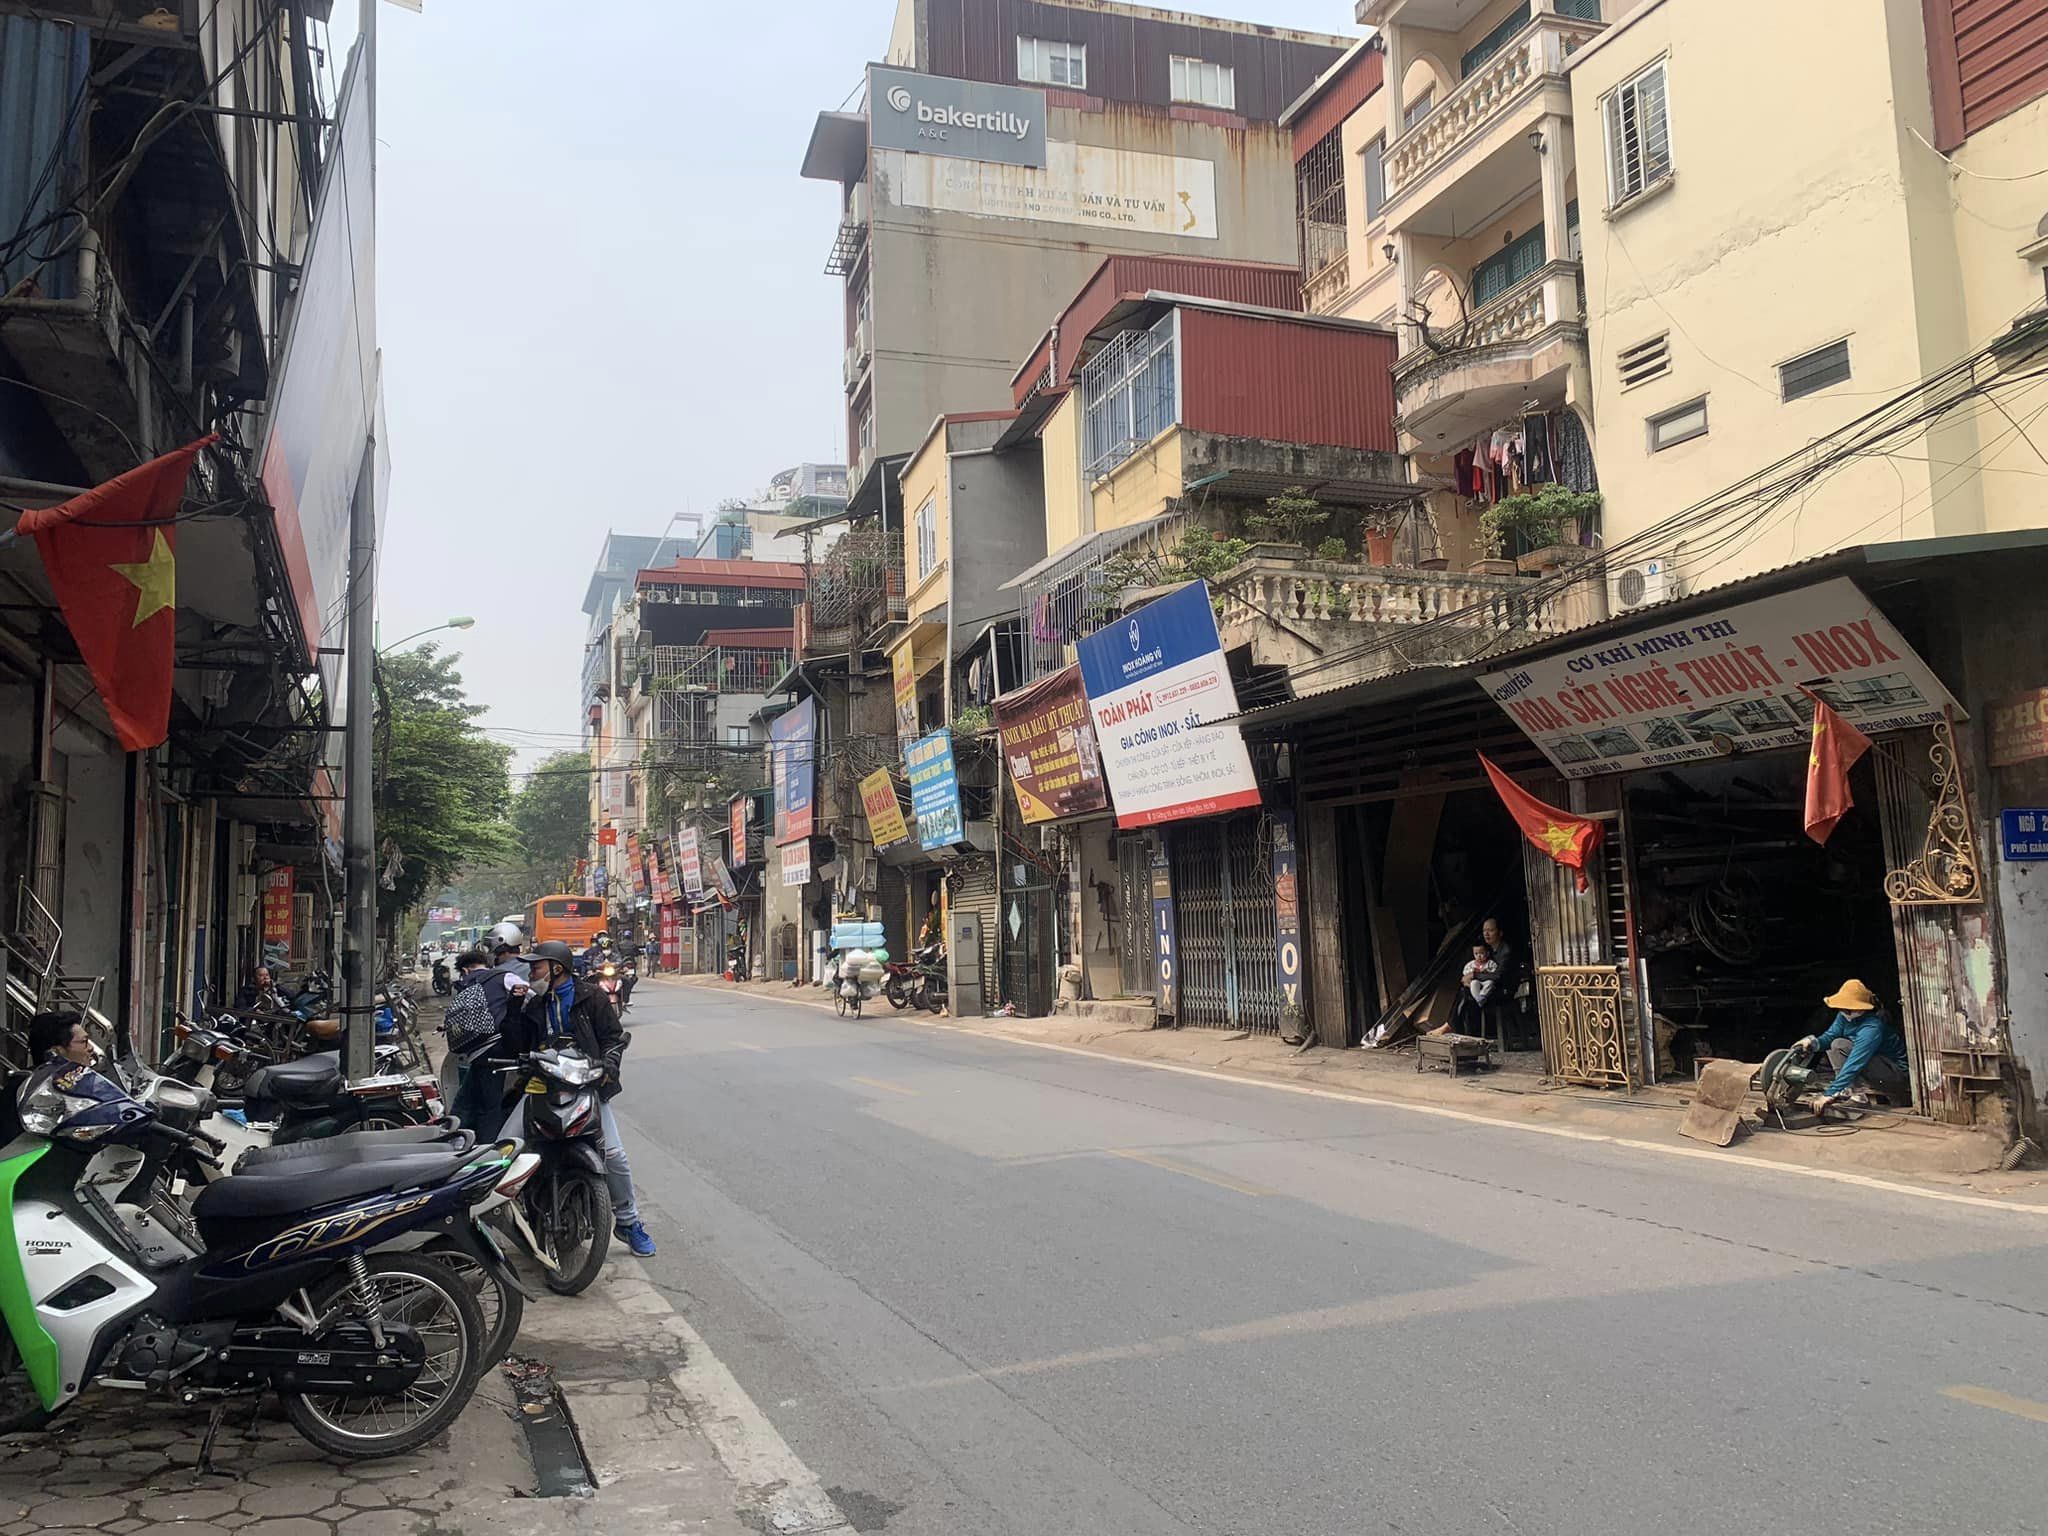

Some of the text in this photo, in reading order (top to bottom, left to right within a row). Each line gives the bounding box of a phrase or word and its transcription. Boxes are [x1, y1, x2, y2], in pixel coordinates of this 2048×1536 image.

[917, 100, 1030, 139] bakertilly
[1633, 631, 1693, 657] MINH
[1692, 619, 1737, 641] THI
[1508, 696, 1572, 733] HOA
[1557, 675, 1617, 724] SẮT
[1603, 660, 1695, 714] NGHỆ
[1675, 642, 1784, 699] THUẬT
[1792, 619, 1901, 675] INOX
[1098, 689, 1153, 728] TOÀN PHÁT
[1121, 735, 1134, 750] GIA
[1134, 728, 1157, 746] CÔNG
[1157, 720, 1180, 739] INOX
[25, 1240, 72, 1248] HONDA
